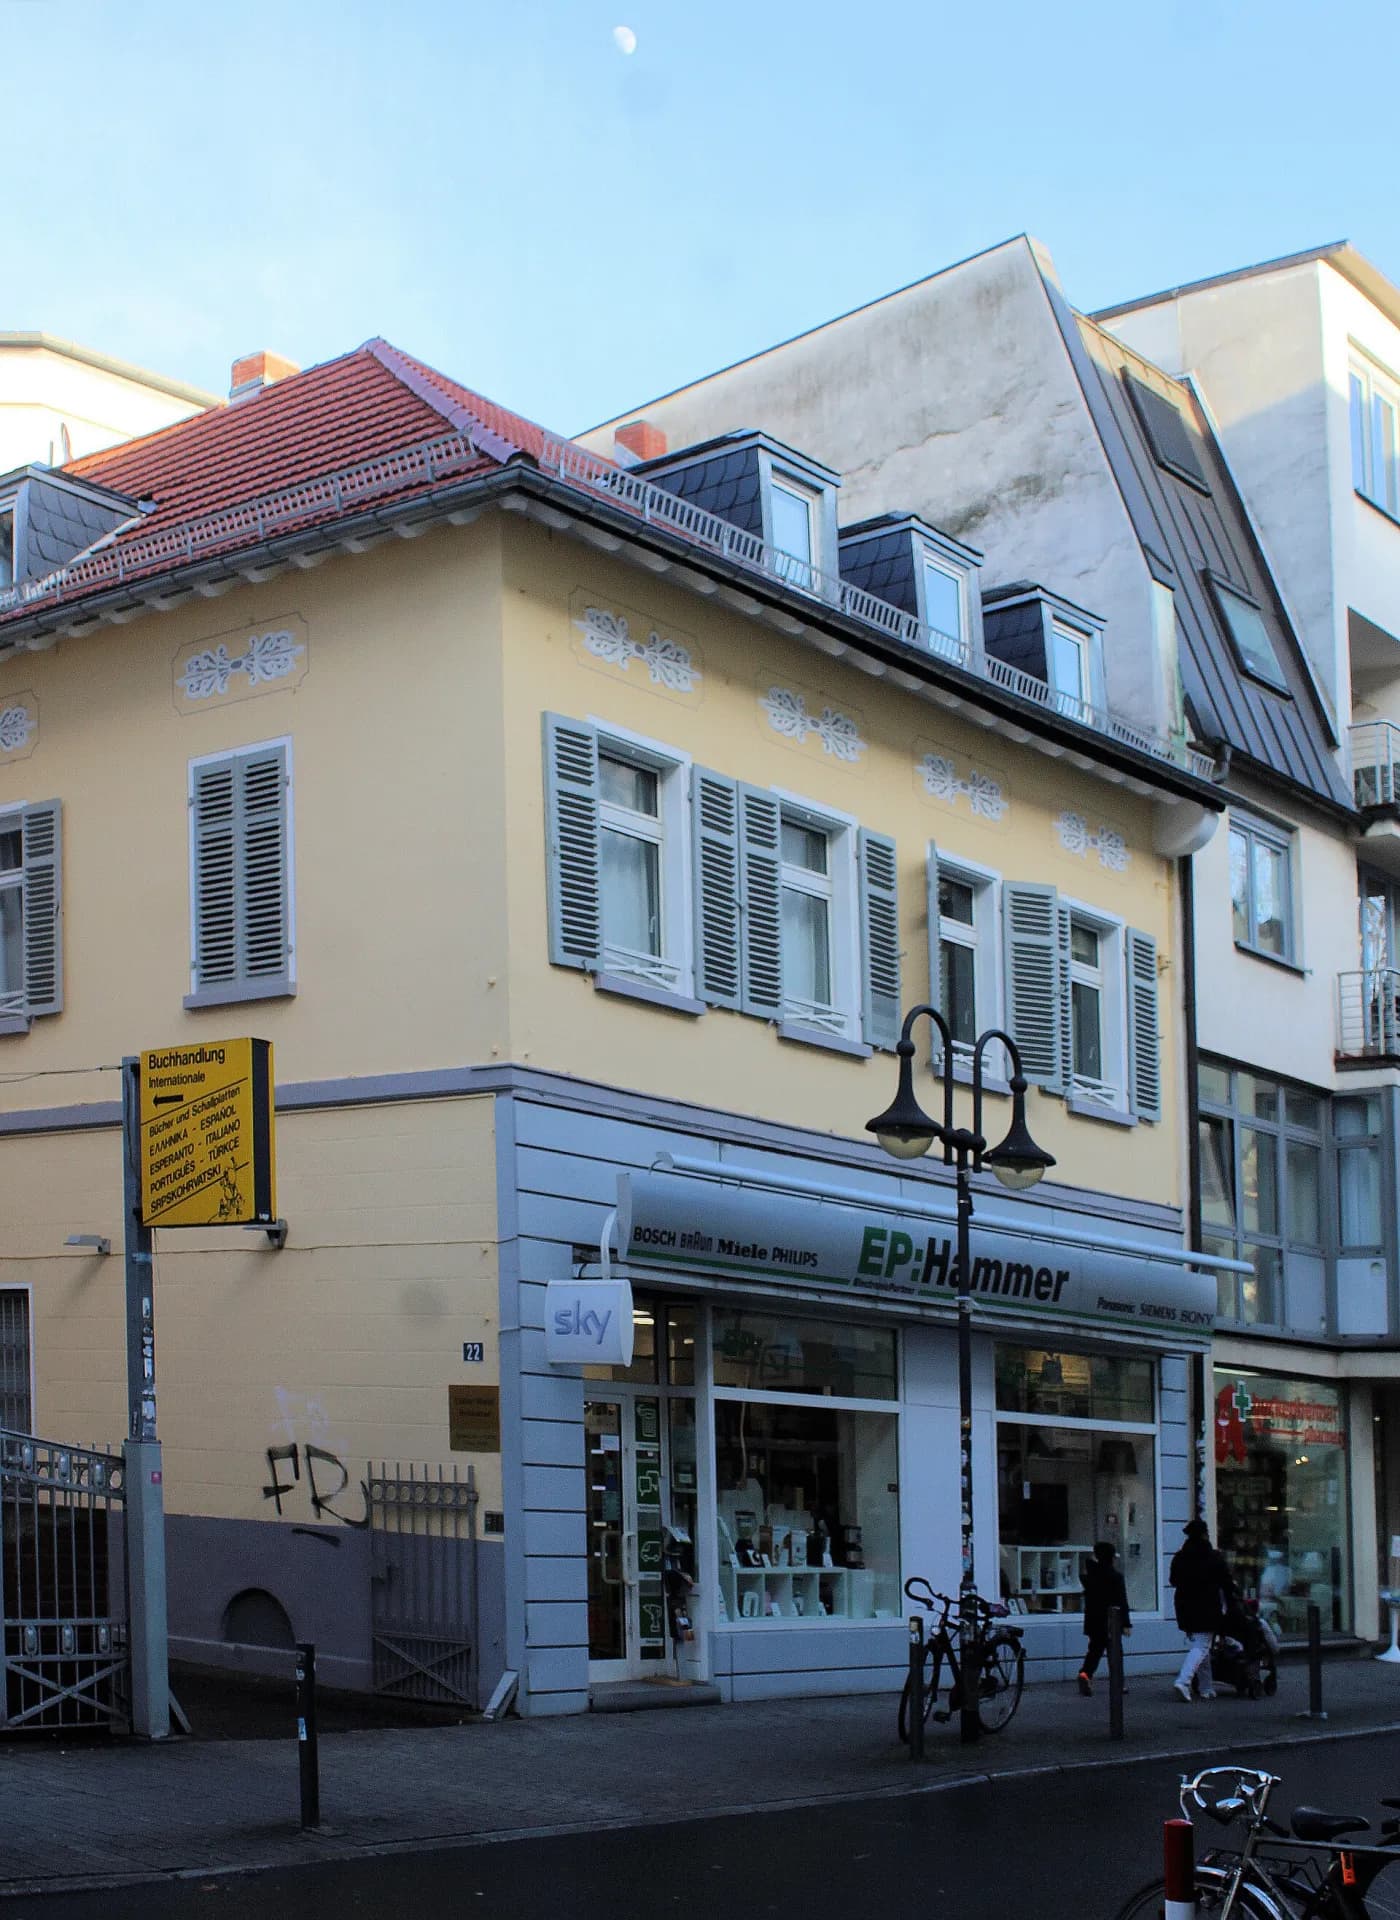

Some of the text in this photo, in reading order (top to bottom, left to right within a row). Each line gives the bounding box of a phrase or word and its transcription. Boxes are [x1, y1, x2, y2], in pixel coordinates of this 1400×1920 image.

[149, 1048, 225, 1070] Buchhandlung
[149, 1071, 206, 1089] Internationale
[149, 1085, 241, 1138] Bücher und Schallplatten
[199, 1104, 237, 1131] ESPAÑOL
[149, 1143, 195, 1176] ESPERANTO
[205, 1118, 241, 1146] ITALIANO
[149, 1160, 196, 1195] PORTUGUÊS
[150, 1163, 221, 1214] SRPSKOHRVATSKI
[633, 1226, 676, 1248] BOSCH
[717, 1238, 768, 1261] Miele
[772, 1247, 819, 1268] PHILIPS
[554, 1300, 612, 1345] sky
[1180, 1309, 1214, 1326] SONY
[466, 1343, 480, 1361] 22
